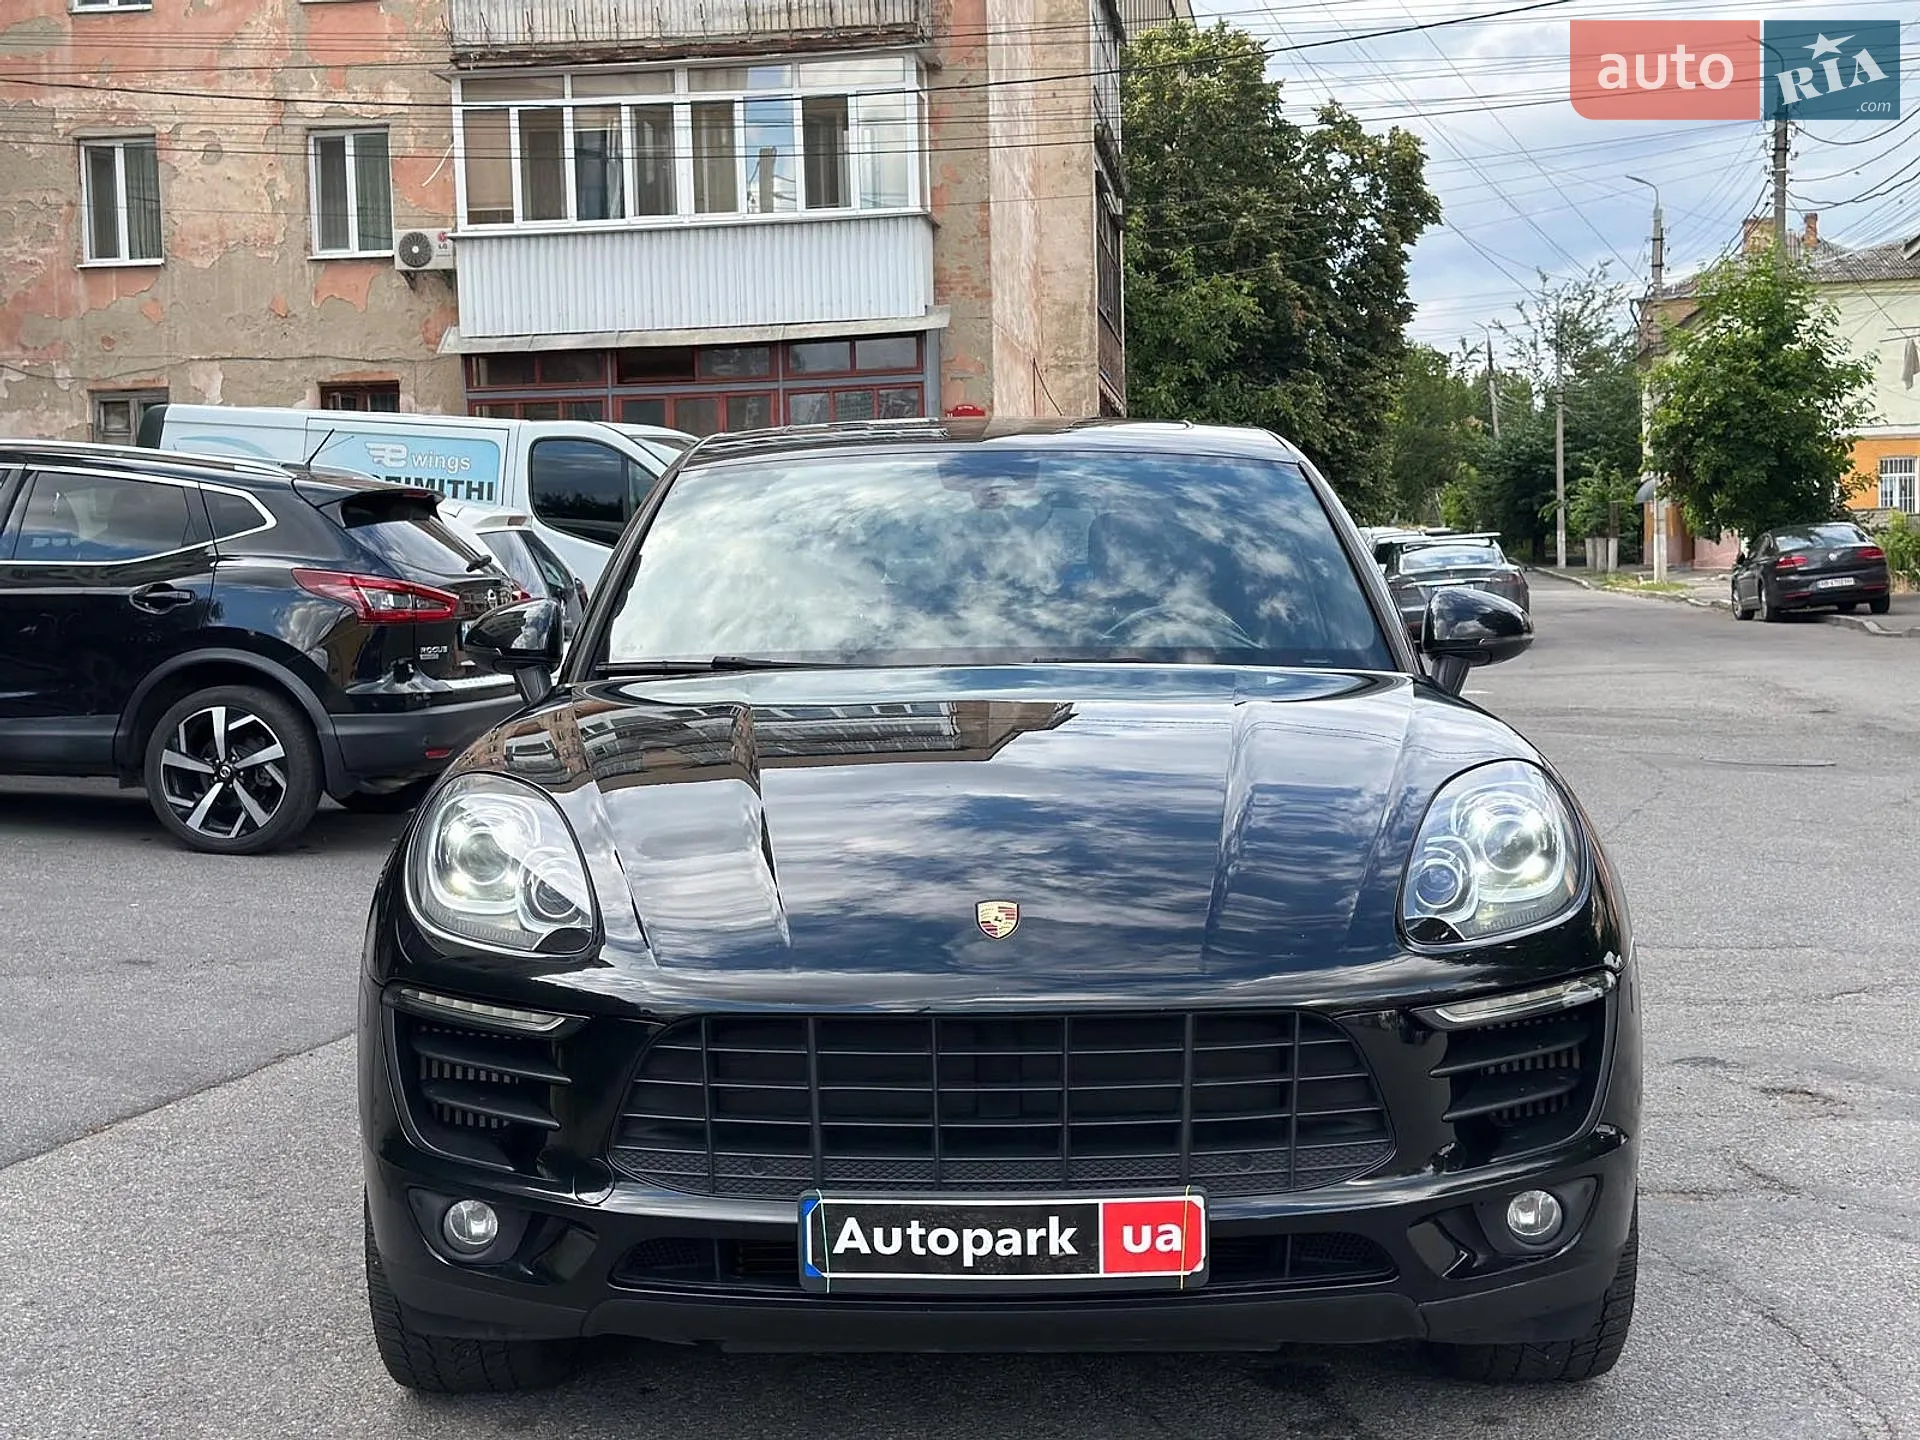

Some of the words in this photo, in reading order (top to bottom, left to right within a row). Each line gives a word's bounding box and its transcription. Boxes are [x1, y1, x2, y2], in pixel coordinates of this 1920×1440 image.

[411, 450, 472, 473] wings
[831, 1215, 1079, 1267] Autopark
[1122, 1222, 1183, 1254] ua
